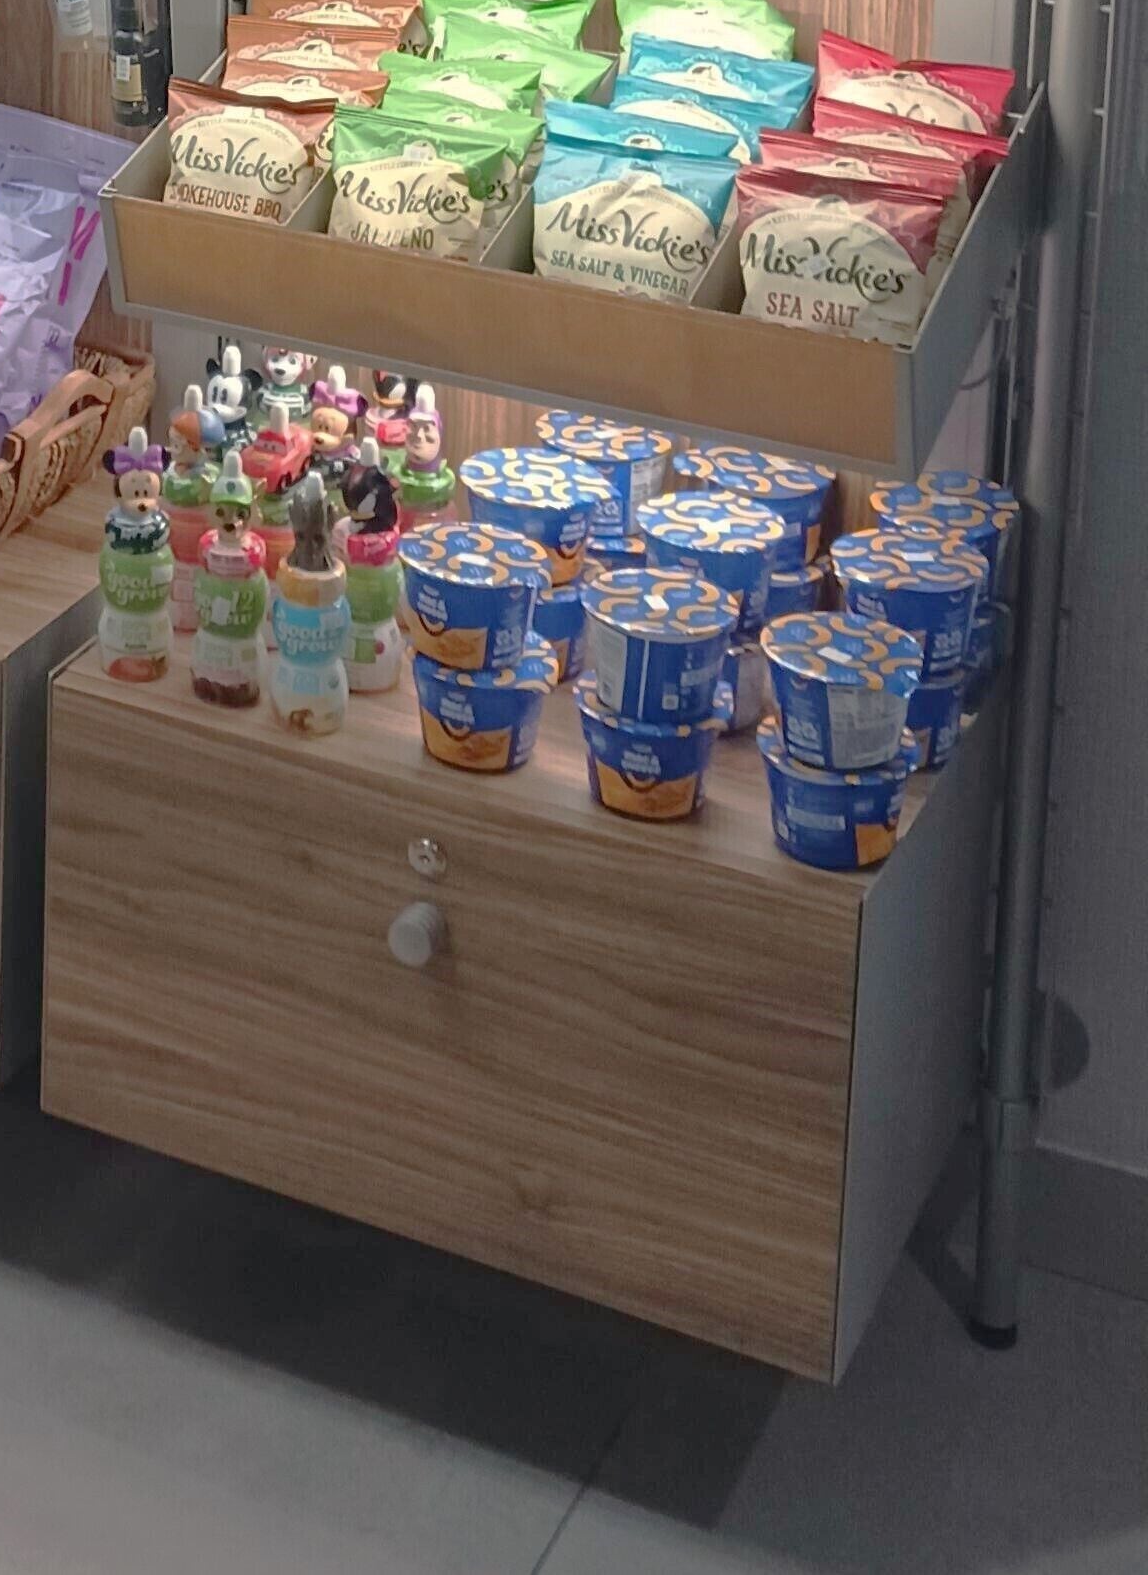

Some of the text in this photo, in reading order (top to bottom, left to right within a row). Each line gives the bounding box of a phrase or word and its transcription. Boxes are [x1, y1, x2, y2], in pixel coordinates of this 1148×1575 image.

[170, 132, 299, 196] Miss Vickie's
[252, 192, 283, 224] BBQ
[339, 170, 472, 225] Miss Vickie's
[547, 202, 712, 273] Miss Vickie's
[550, 249, 690, 296] SEA SALT & VINEGAR
[766, 291, 860, 329] SEA SALT
